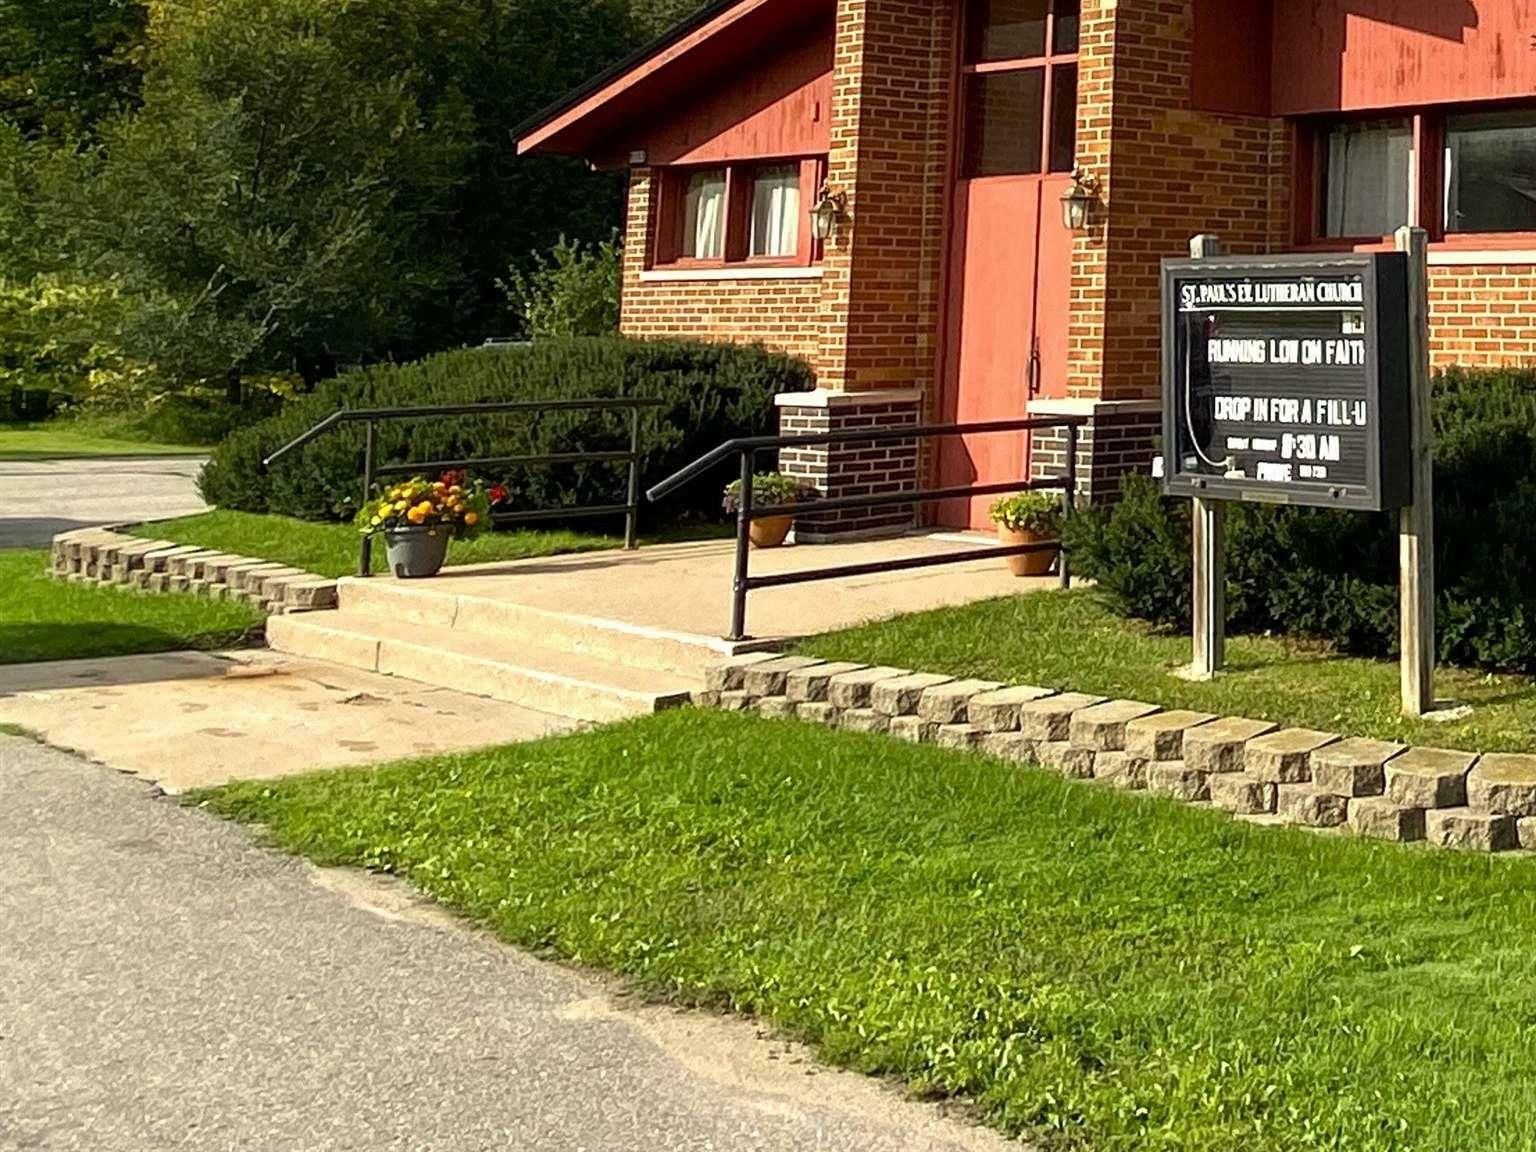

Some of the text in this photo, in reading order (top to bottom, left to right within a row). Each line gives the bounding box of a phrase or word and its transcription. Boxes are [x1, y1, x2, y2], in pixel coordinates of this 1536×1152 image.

[1200, 284, 1236, 303] PAUL'S
[1255, 282, 1315, 303] LUTHERAN
[1316, 282, 1363, 303] CHURCH
[1207, 339, 1266, 363] RUNNING
[1270, 339, 1299, 364] LOW
[1301, 339, 1322, 365] ON
[1214, 396, 1251, 421] DROP
[1253, 397, 1268, 422] IN
[1270, 398, 1299, 424] FOR
[1300, 398, 1312, 424] A
[1318, 434, 1340, 461] AM
